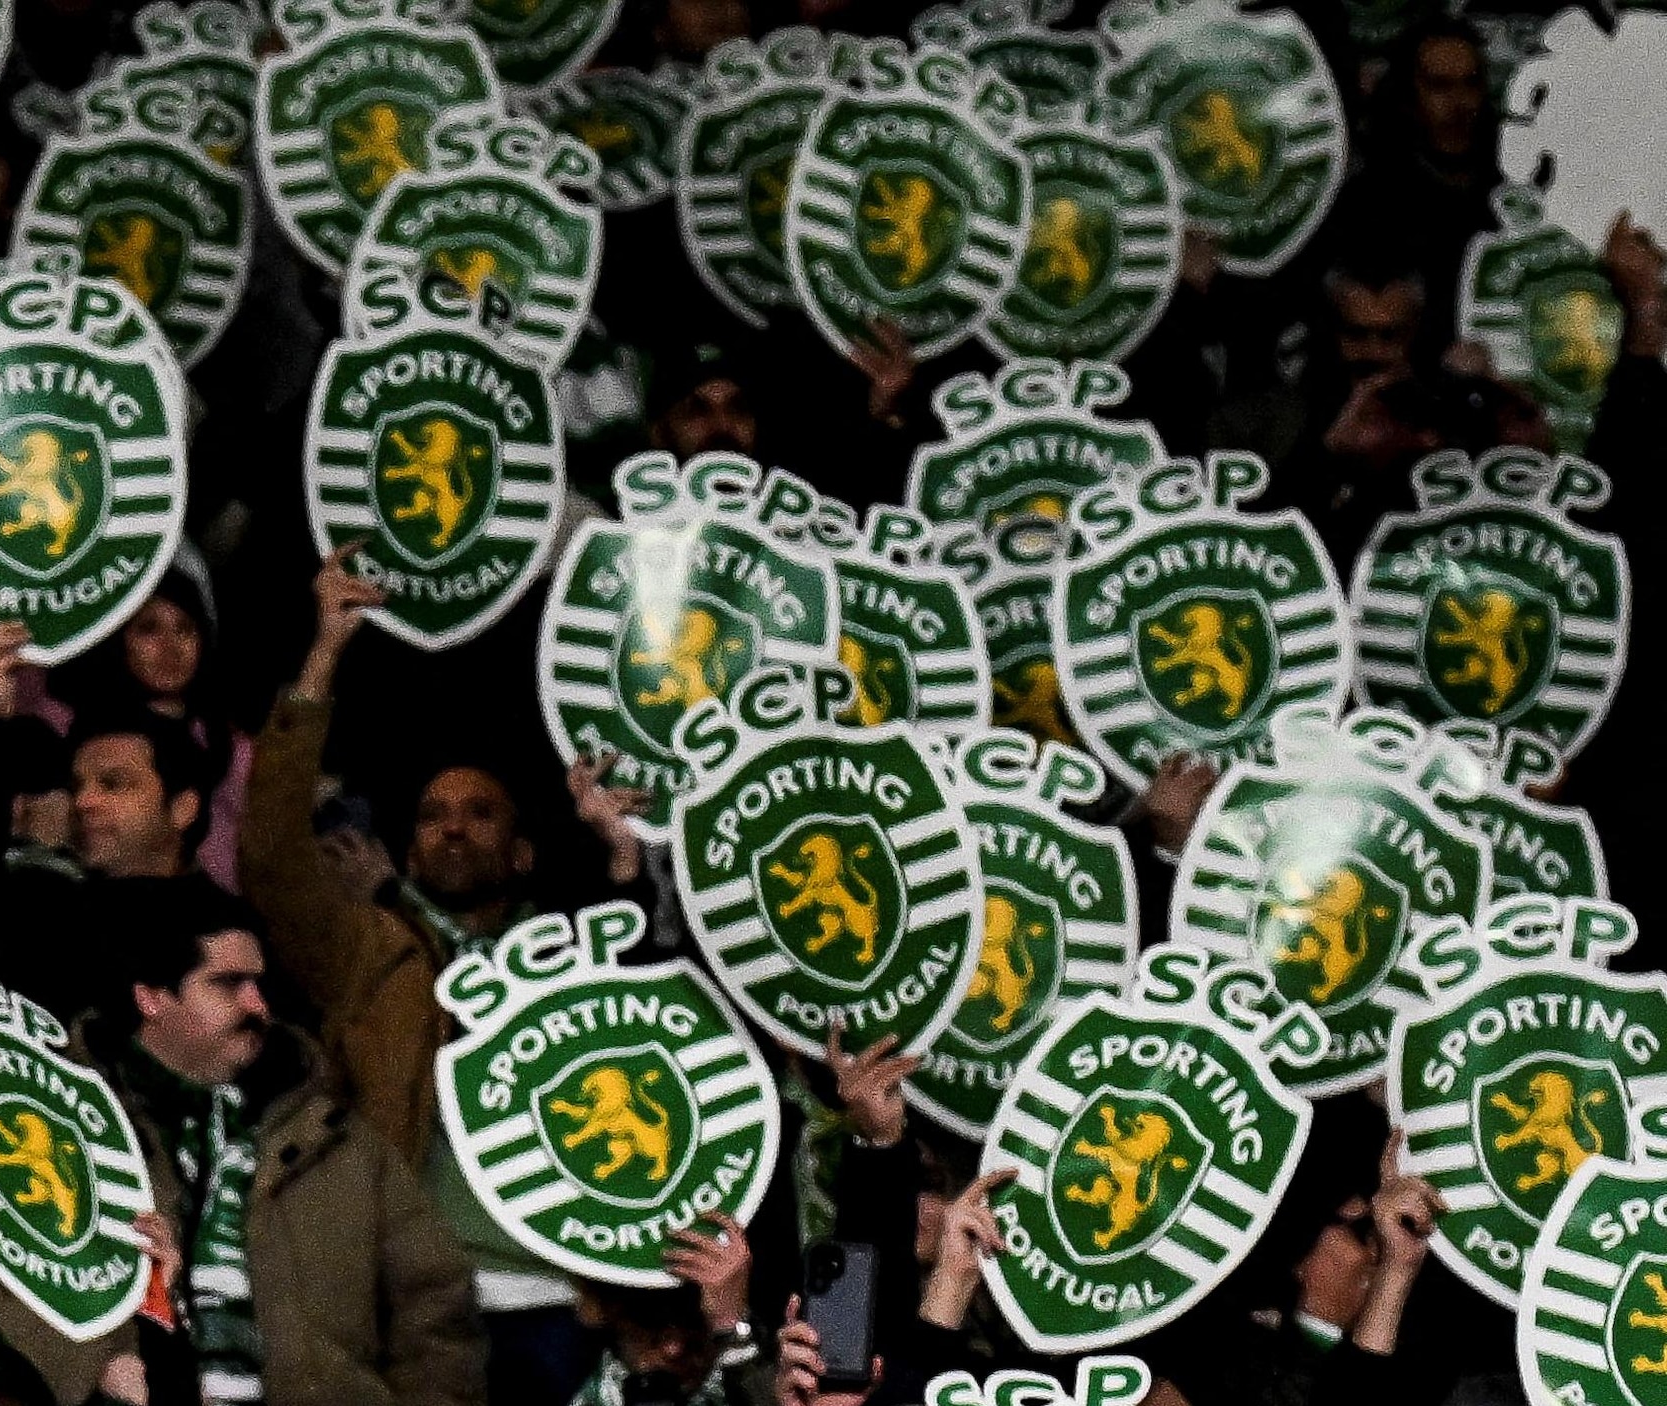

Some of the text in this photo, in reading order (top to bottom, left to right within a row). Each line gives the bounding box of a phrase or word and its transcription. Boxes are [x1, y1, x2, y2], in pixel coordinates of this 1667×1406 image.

[866, 44, 1021, 123] SCP
[432, 123, 596, 185] SCP
[357, 268, 535, 332] SCP
[340, 347, 534, 434] SPORTING
[946, 367, 1119, 427] SCP
[622, 460, 821, 529] SCP
[1073, 460, 1267, 547] SCP
[1418, 452, 1608, 513] SCP
[1084, 534, 1299, 631] SPORTING
[1391, 523, 1600, 610] SPORTING
[673, 665, 866, 776] SCP
[705, 753, 913, 872] SPORTING
[437, 915, 644, 1026] SCP
[776, 943, 955, 1034] PORTUGAL
[1411, 898, 1633, 993] SCP
[1136, 943, 1323, 1064] SCP
[1420, 993, 1659, 1096] SPORTING
[478, 992, 699, 1114] SPORTING
[1066, 1032, 1262, 1171] SPORTING
[990, 1201, 1167, 1308] PORTUGAL
